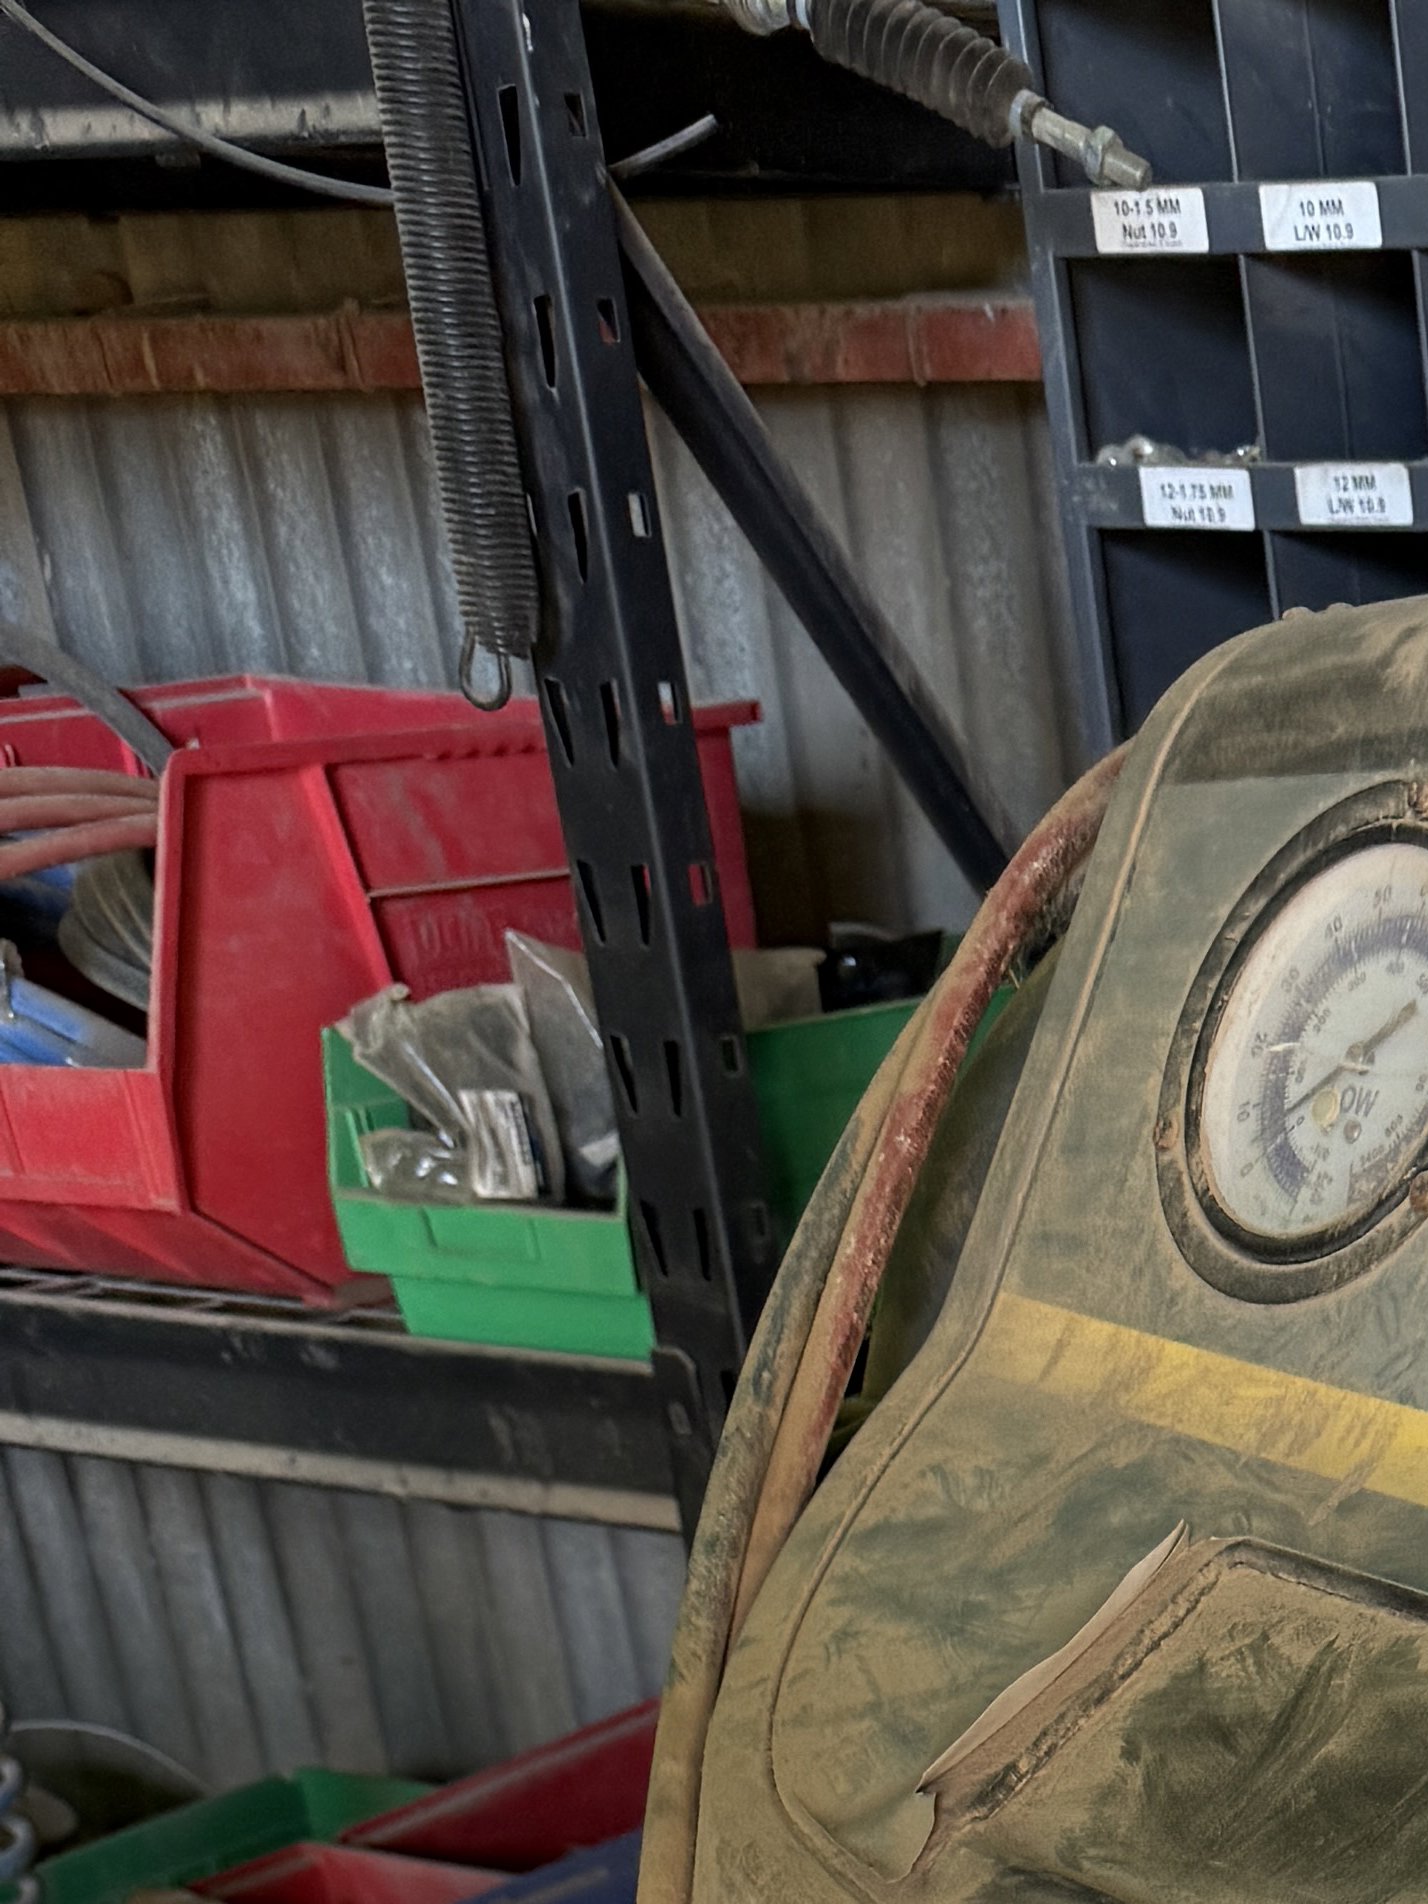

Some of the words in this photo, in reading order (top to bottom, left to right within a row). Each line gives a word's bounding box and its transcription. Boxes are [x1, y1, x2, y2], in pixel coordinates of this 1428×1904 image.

[1114, 198, 1154, 216] 10-1.5
[1156, 197, 1181, 214] MM
[1299, 200, 1315, 217] 10
[1319, 199, 1344, 216] MM
[1122, 222, 1146, 240] Nut
[1151, 222, 1177, 239] 10.9
[1294, 225, 1320, 242] L/W
[1325, 223, 1354, 240] 10.9
[1160, 483, 1207, 500] 12-1.75
[1209, 483, 1234, 500] MM
[1333, 475, 1349, 491] 12
[1351, 474, 1377, 490] MM
[1172, 504, 1196, 521] Nut
[1199, 504, 1226, 522] 10.9
[1327, 498, 1355, 515] L/W
[1358, 497, 1386, 514] 10.9
[1340, 1084, 1380, 1119] OW
[1237, 1102, 1250, 1123] 10
